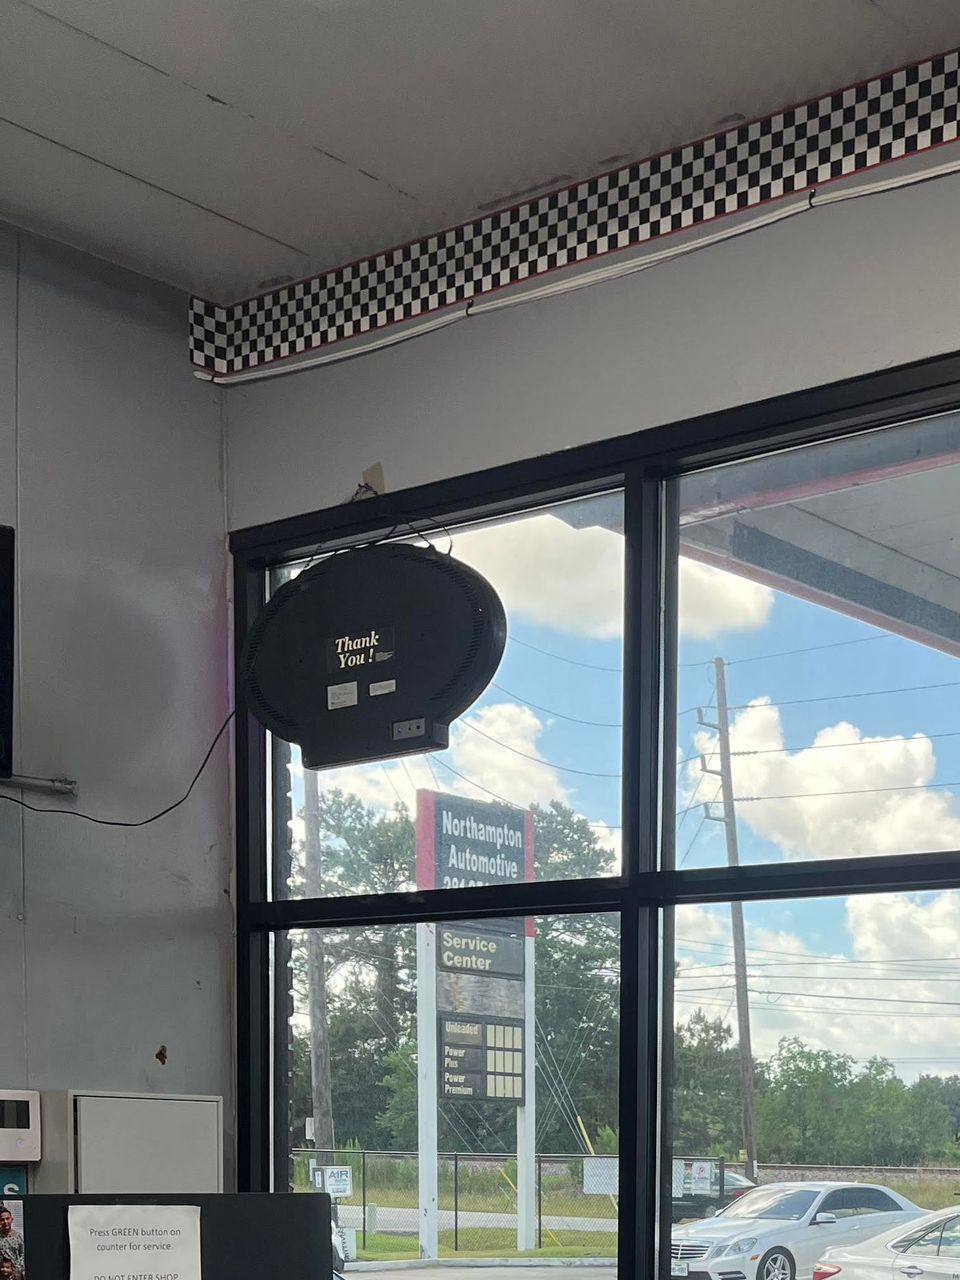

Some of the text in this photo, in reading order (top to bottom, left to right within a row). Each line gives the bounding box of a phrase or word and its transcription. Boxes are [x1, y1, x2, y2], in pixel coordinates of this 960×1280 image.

[335, 631, 379, 653] Thank
[338, 653, 365, 668] You
[442, 810, 522, 849] Northampton
[448, 844, 518, 878] Automotive
[442, 932, 497, 953] Service
[442, 951, 492, 970] Center
[445, 1021, 479, 1035] Unleaded
[444, 1045, 466, 1057] Power
[444, 1058, 458, 1068] Plus
[444, 1072, 466, 1083] Power
[444, 1084, 473, 1095] Premium
[89, 1228, 110, 1236] Press
[112, 1228, 139, 1236] GREEN
[141, 1228, 168, 1236] button
[96, 1243, 127, 1251] counter
[129, 1242, 141, 1250] for
